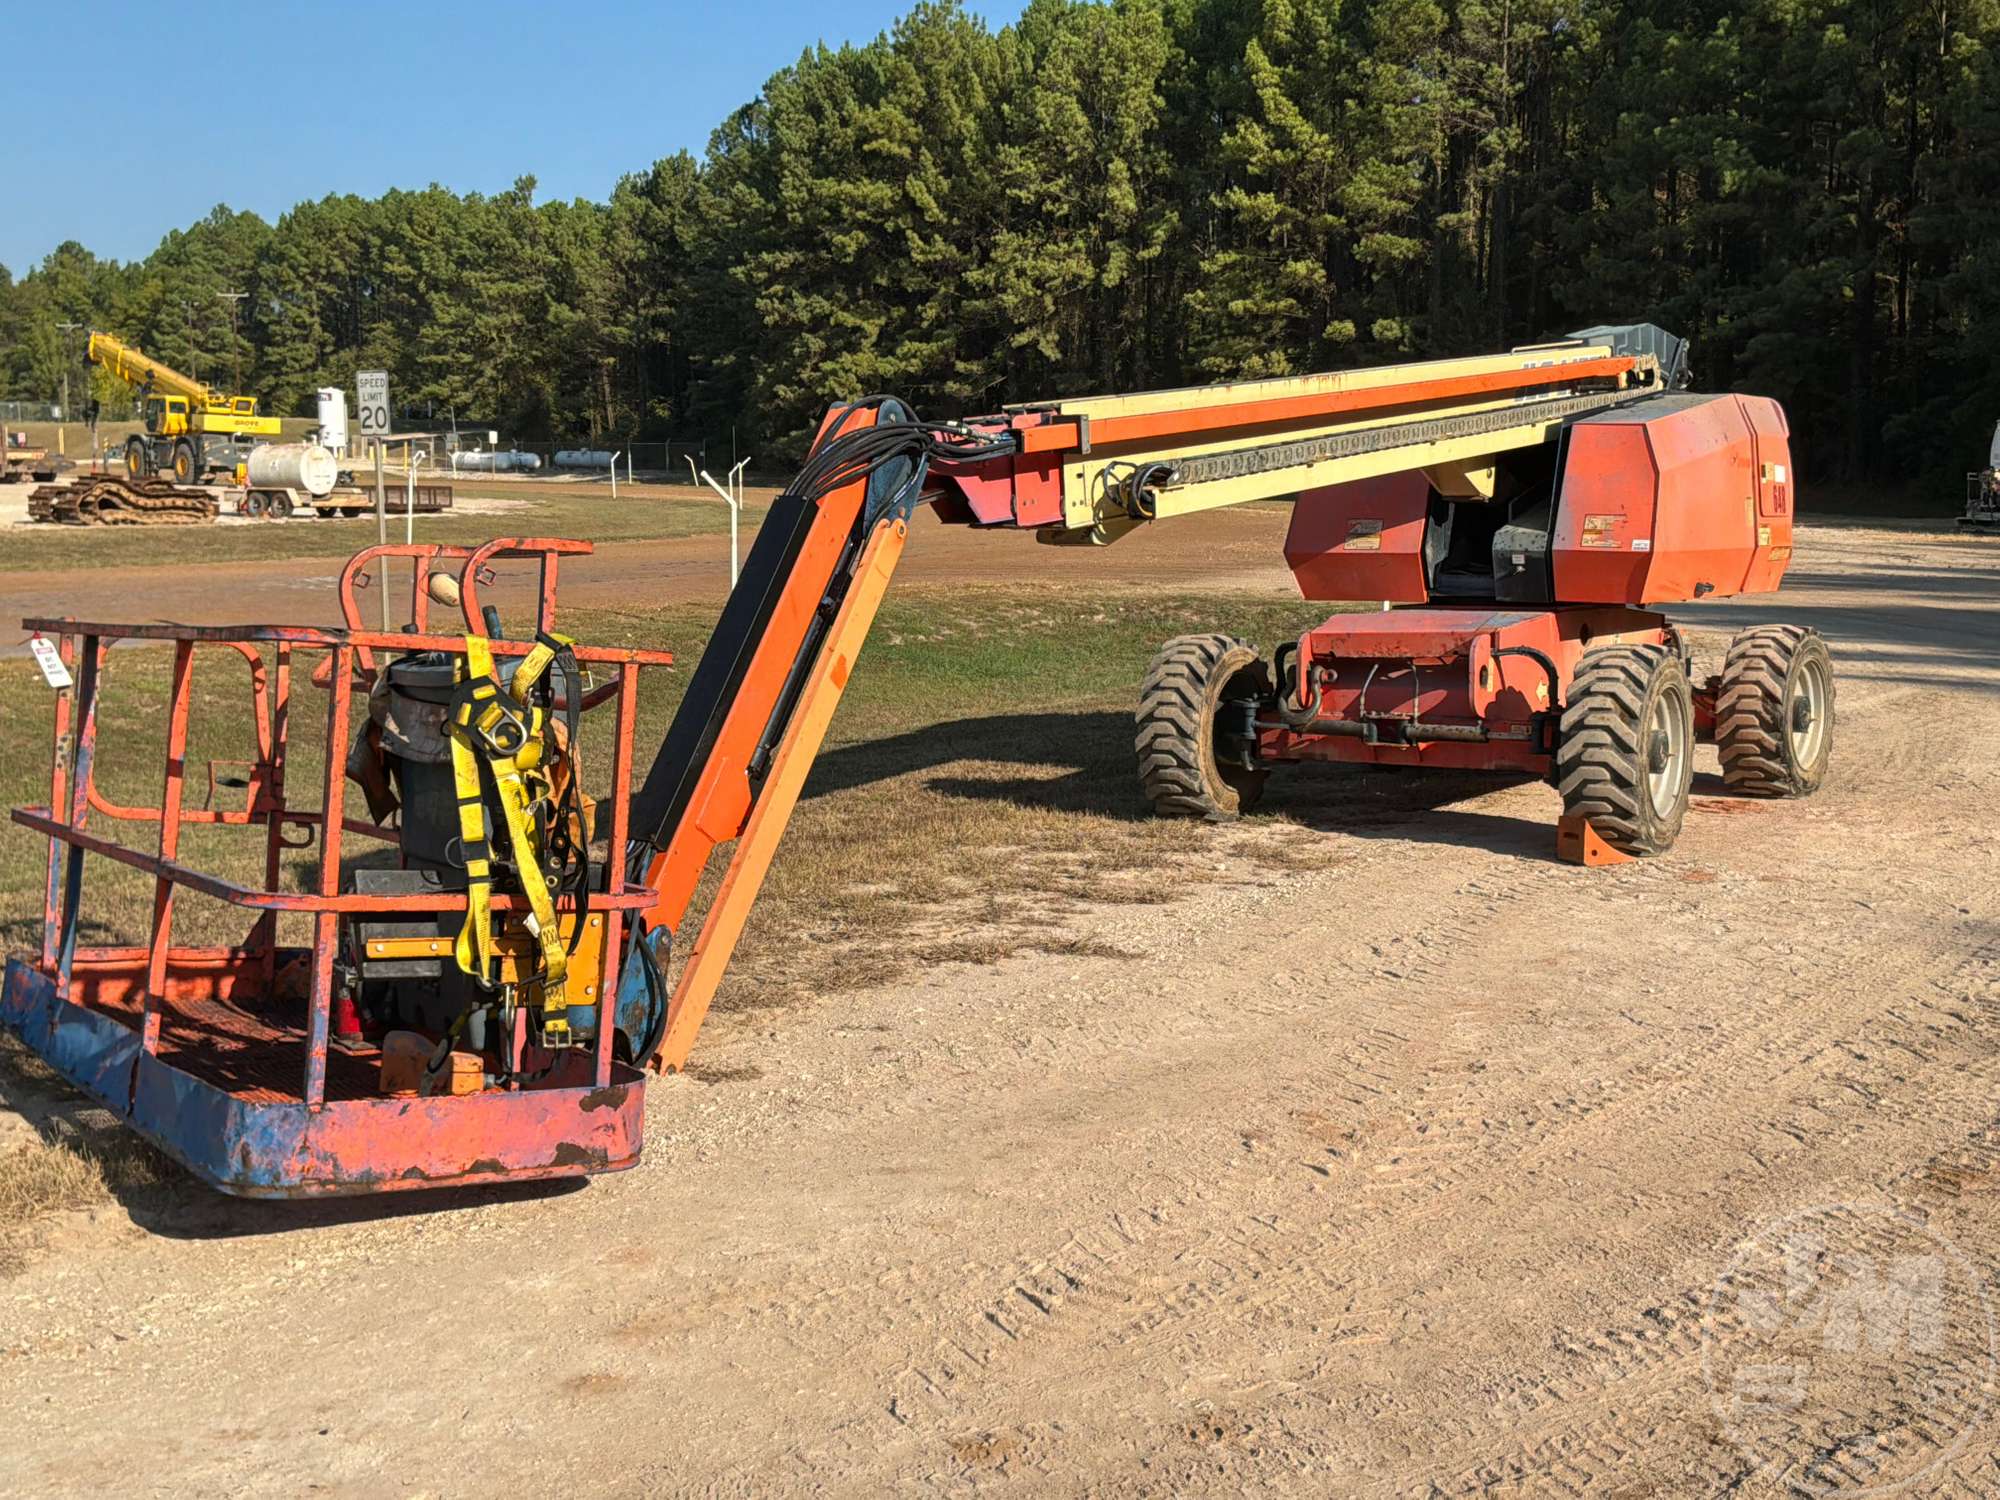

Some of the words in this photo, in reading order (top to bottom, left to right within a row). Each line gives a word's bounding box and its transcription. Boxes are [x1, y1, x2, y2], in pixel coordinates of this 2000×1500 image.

[359, 378, 385, 388] SPEED
[362, 392, 383, 402] LIMIT
[361, 406, 387, 429] 20
